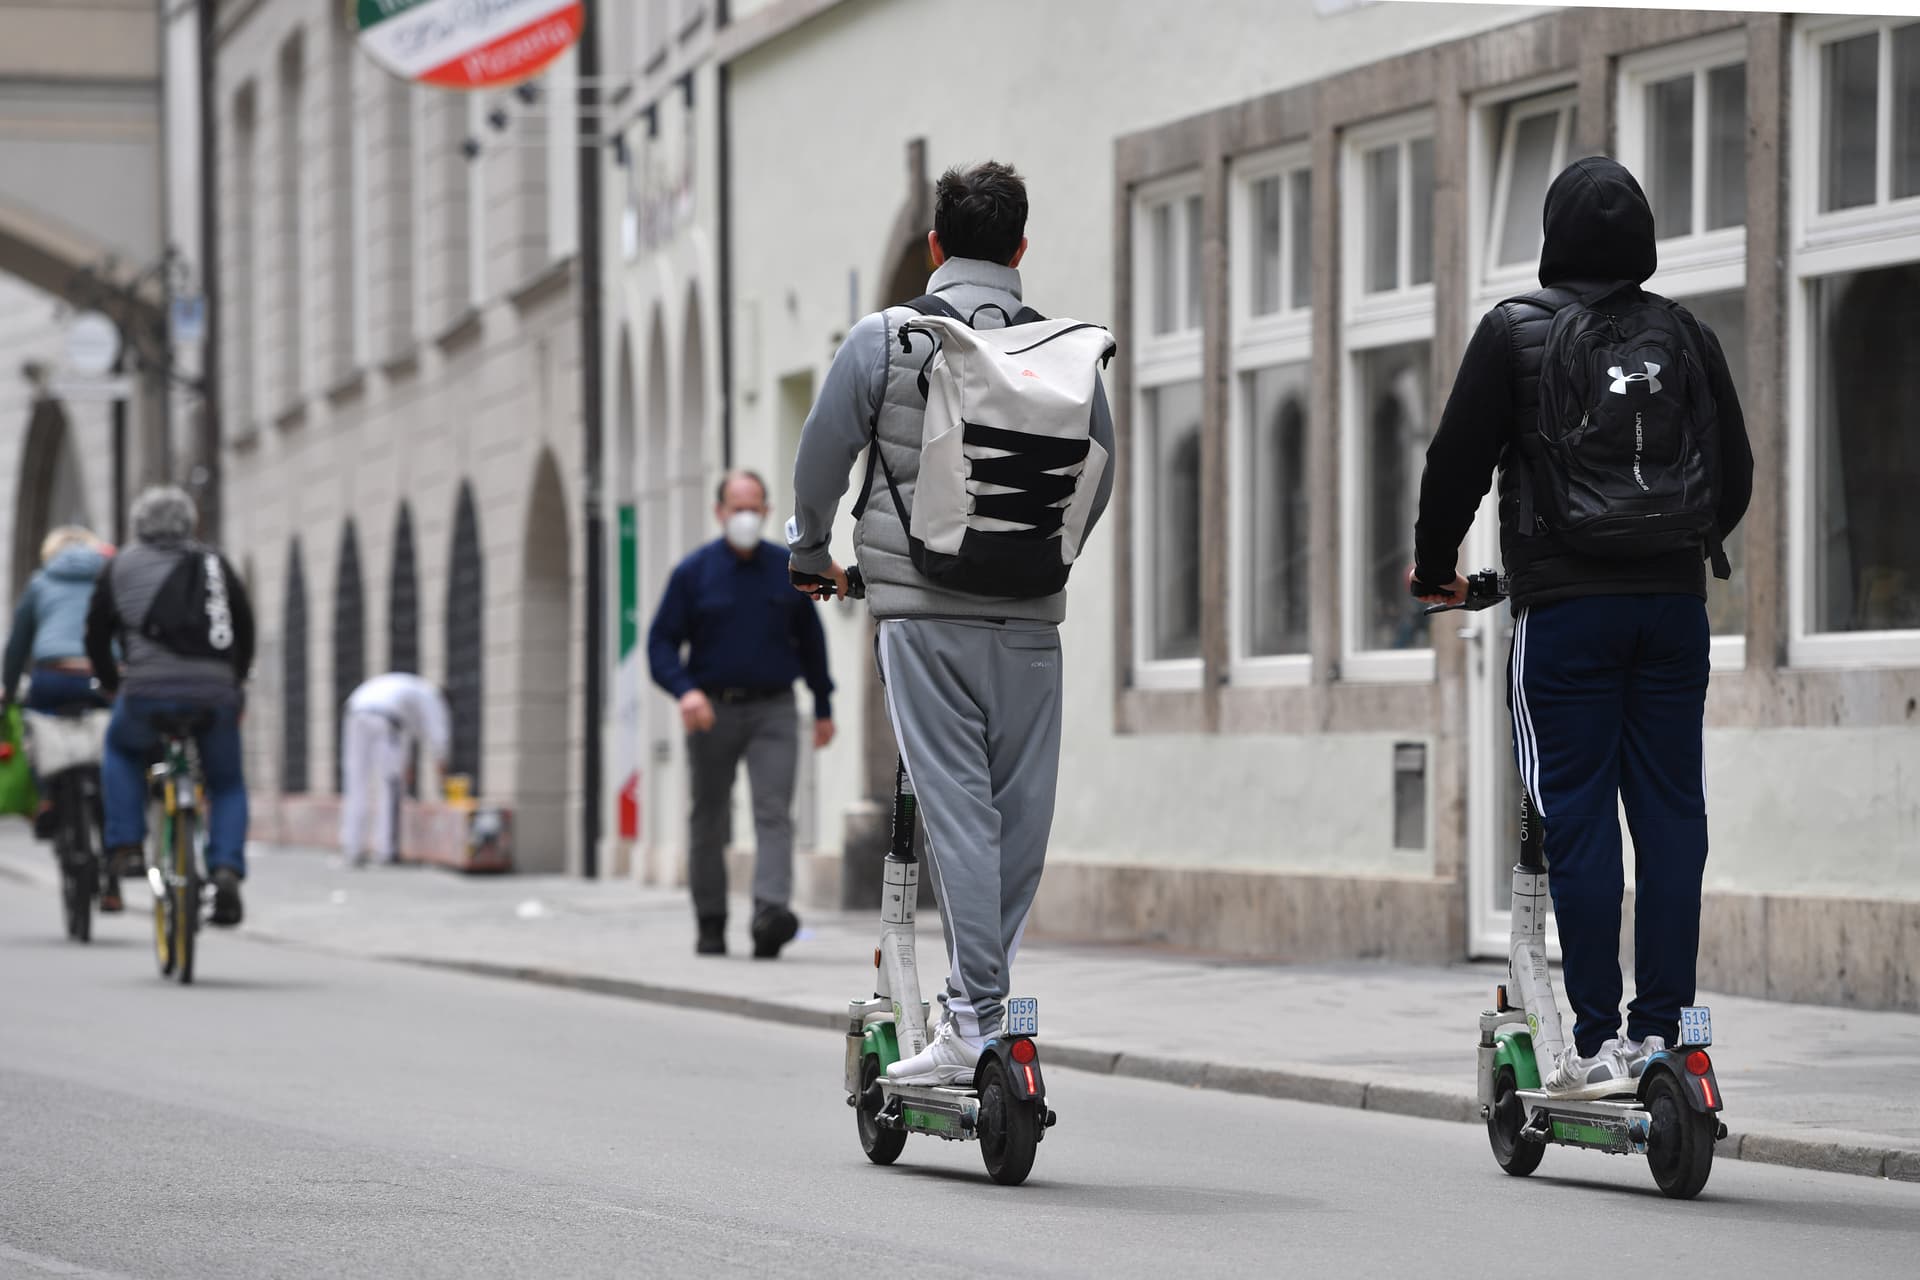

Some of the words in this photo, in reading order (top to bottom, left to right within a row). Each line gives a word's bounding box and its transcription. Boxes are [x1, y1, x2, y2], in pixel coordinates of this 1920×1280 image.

[1635, 411, 1643, 451] UNDER
[1520, 821, 1529, 841] On
[1013, 1017, 1034, 1031] IFG
[1684, 1011, 1706, 1025] 519
